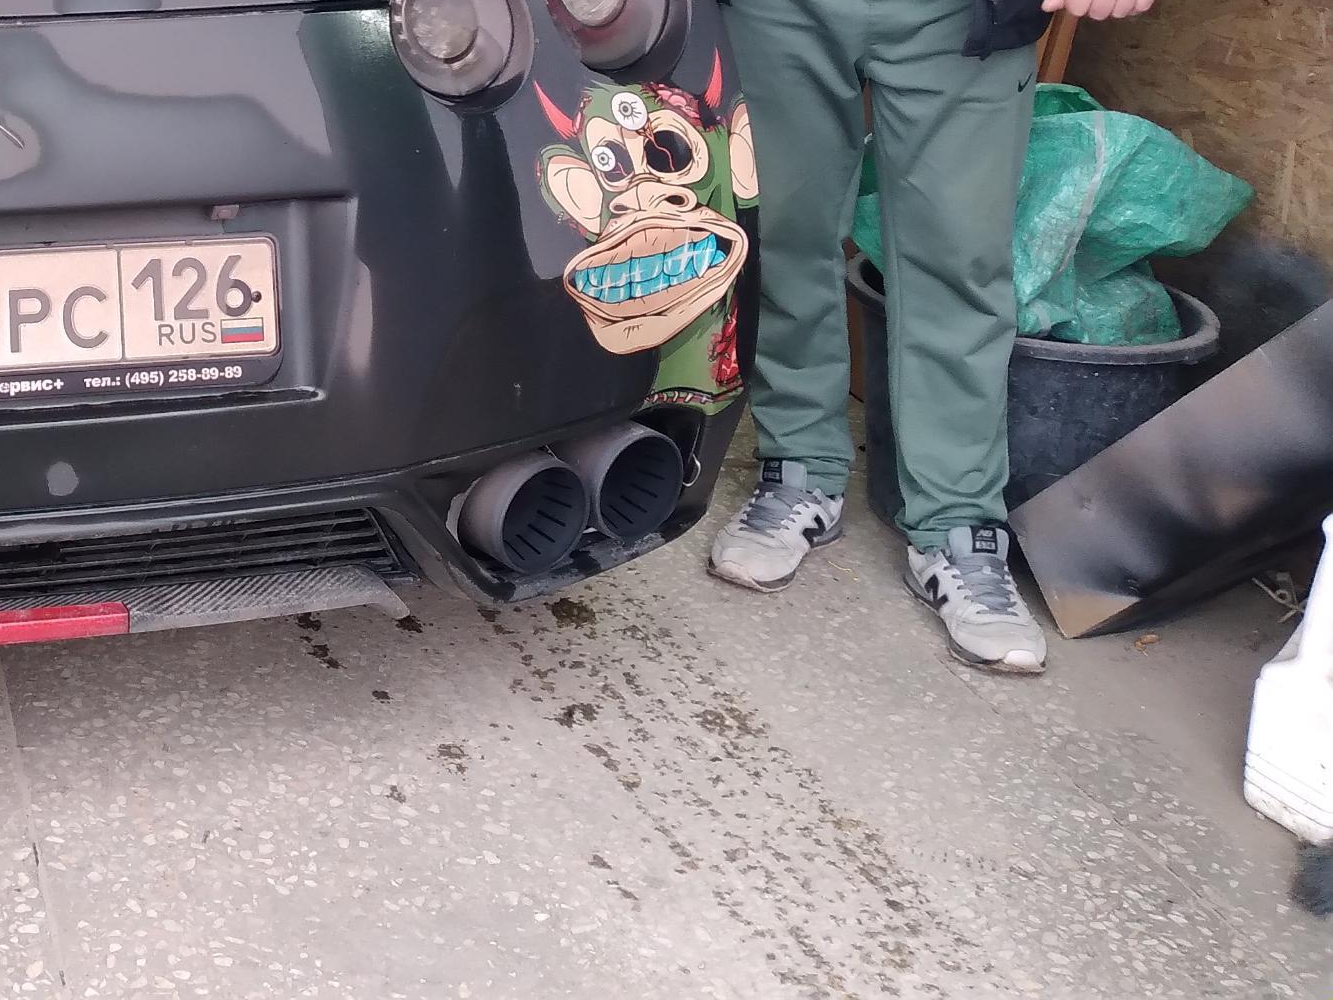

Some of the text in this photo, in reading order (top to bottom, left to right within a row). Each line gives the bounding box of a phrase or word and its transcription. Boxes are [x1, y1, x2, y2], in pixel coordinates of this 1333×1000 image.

[131, 254, 253, 321] 126
[157, 321, 218, 347] RUS
[83, 376, 121, 389] тел.:
[124, 371, 165, 389] (495)
[168, 365, 243, 383] 258-89-89
